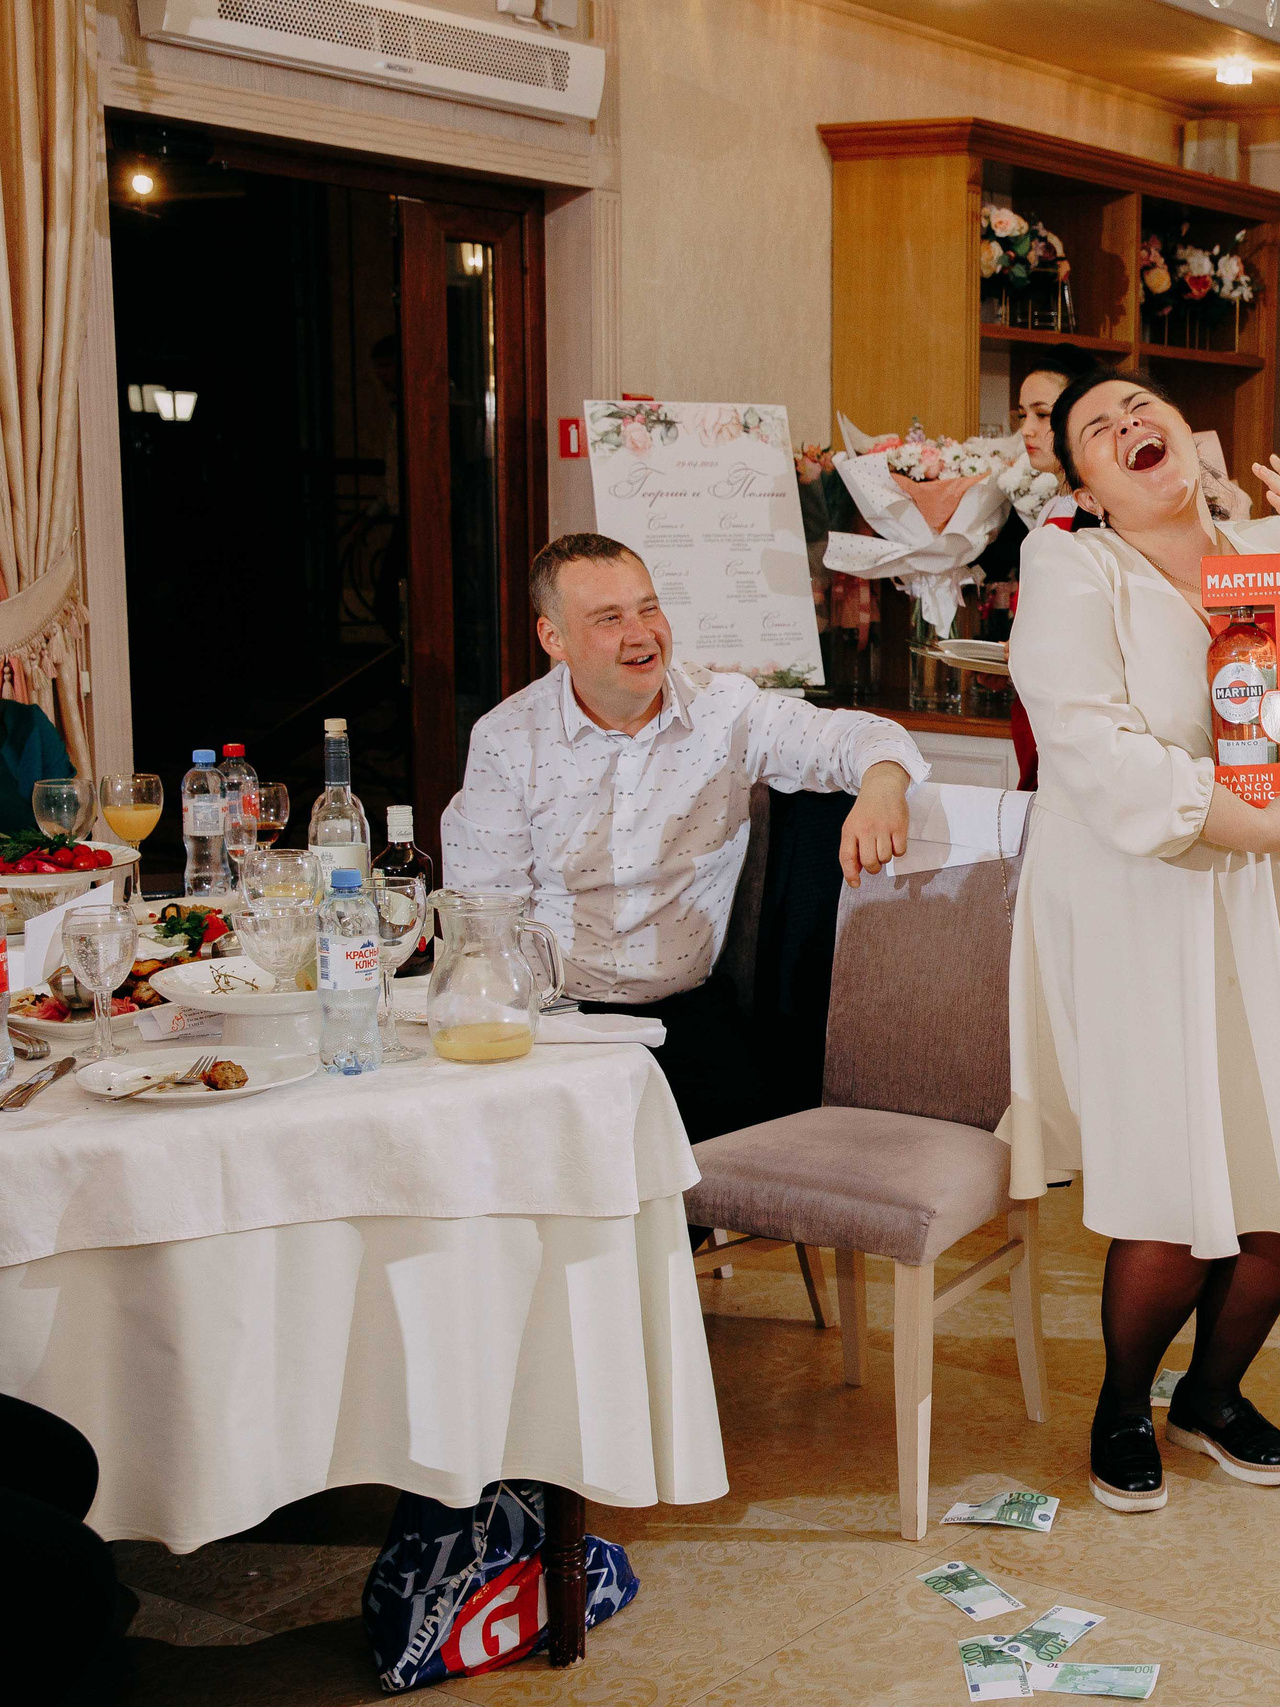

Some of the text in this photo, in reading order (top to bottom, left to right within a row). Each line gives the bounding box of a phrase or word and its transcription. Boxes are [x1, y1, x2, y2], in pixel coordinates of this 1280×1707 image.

[1207, 572, 1280, 589] MARTINI
[1217, 686, 1262, 699] MARTINI
[1220, 773, 1274, 783] MARTINI
[1230, 782, 1272, 792] IANCO
[1236, 791, 1275, 801] TONIC
[1013, 1493, 1049, 1505] 100
[925, 1576, 948, 1594] 100
[380, 1597, 450, 1693] ЛУЧШАЯ
[1036, 1639, 1068, 1661] 100
[961, 1643, 983, 1665] 100
[1134, 1665, 1154, 1674] 100
